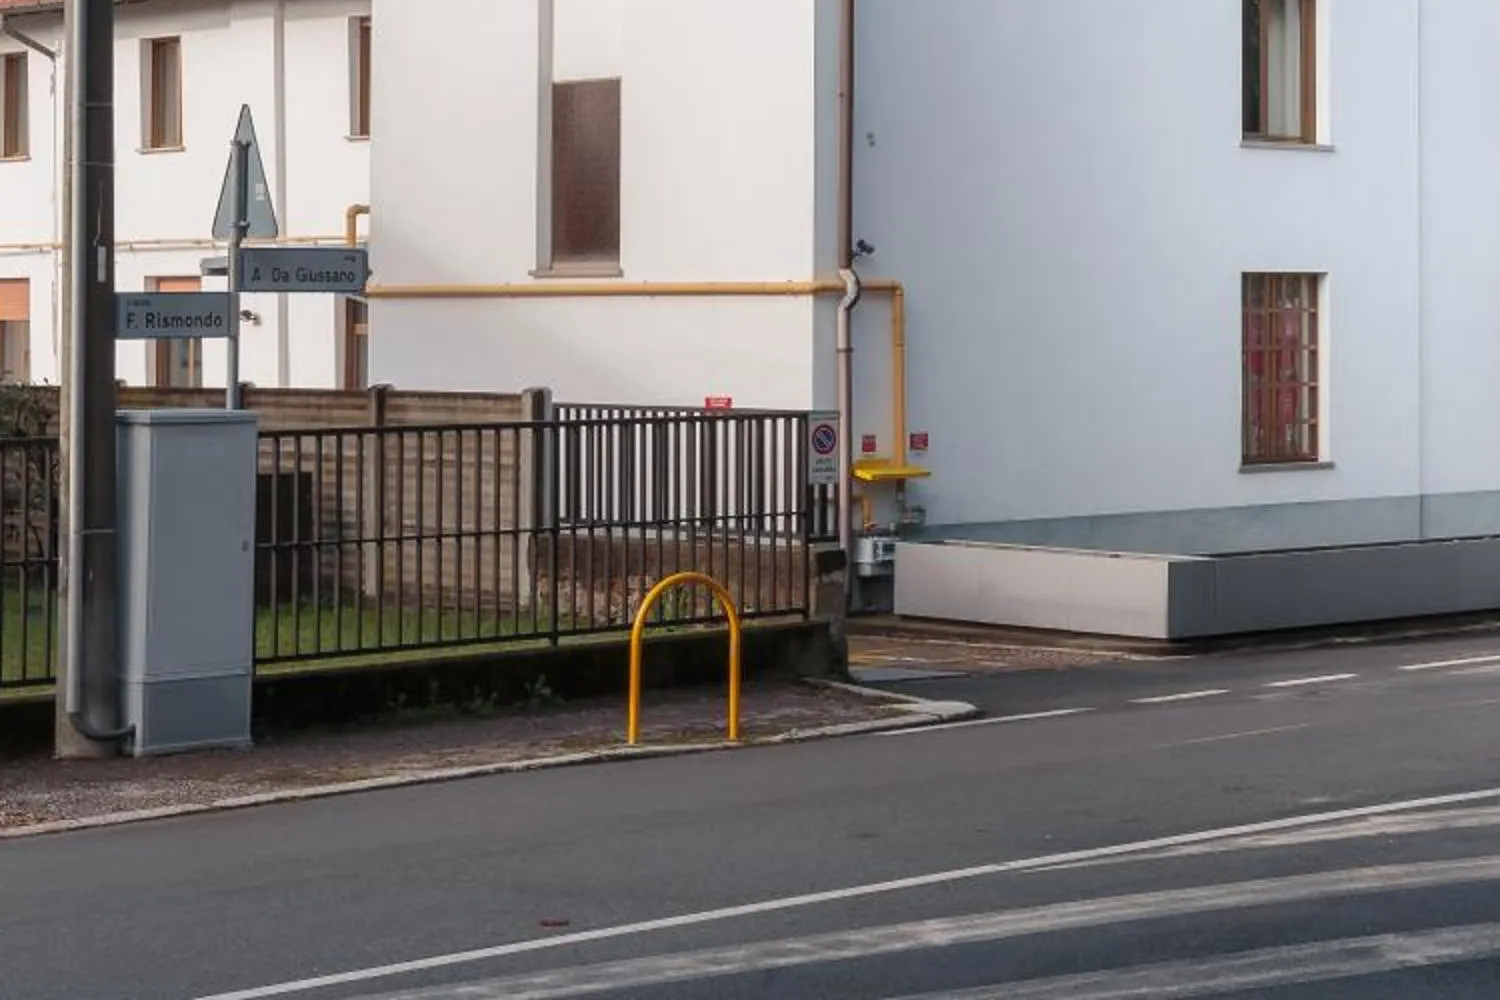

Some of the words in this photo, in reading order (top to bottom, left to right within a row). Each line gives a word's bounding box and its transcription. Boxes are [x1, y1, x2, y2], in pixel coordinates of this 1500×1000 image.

[272, 267, 289, 282] Da
[126, 312, 139, 329] F.
[145, 311, 223, 329] Rismondo
